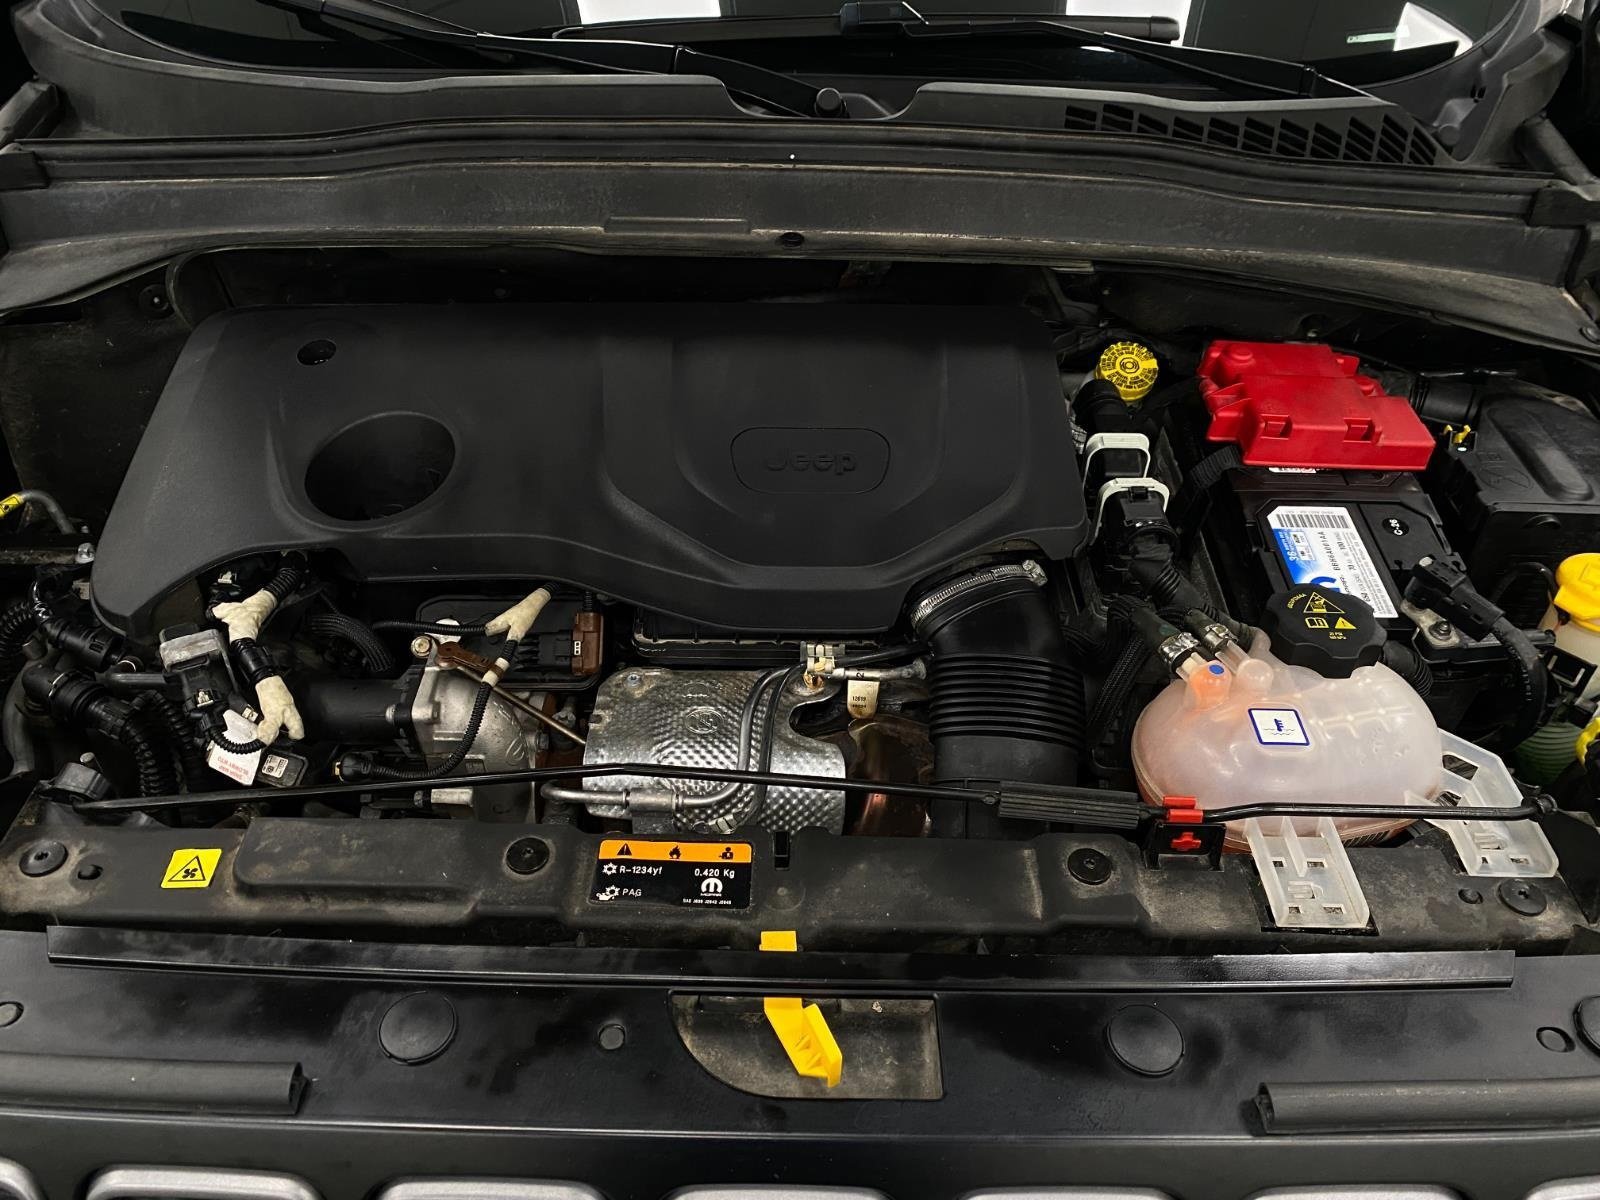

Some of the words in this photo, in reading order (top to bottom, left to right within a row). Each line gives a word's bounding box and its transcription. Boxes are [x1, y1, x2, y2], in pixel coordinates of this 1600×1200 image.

[764, 451, 857, 476] Jeep
[619, 865, 663, 877] R-1234yf
[694, 868, 720, 877] 0.420
[723, 868, 736, 879] Kg
[622, 888, 642, 897] PAG
